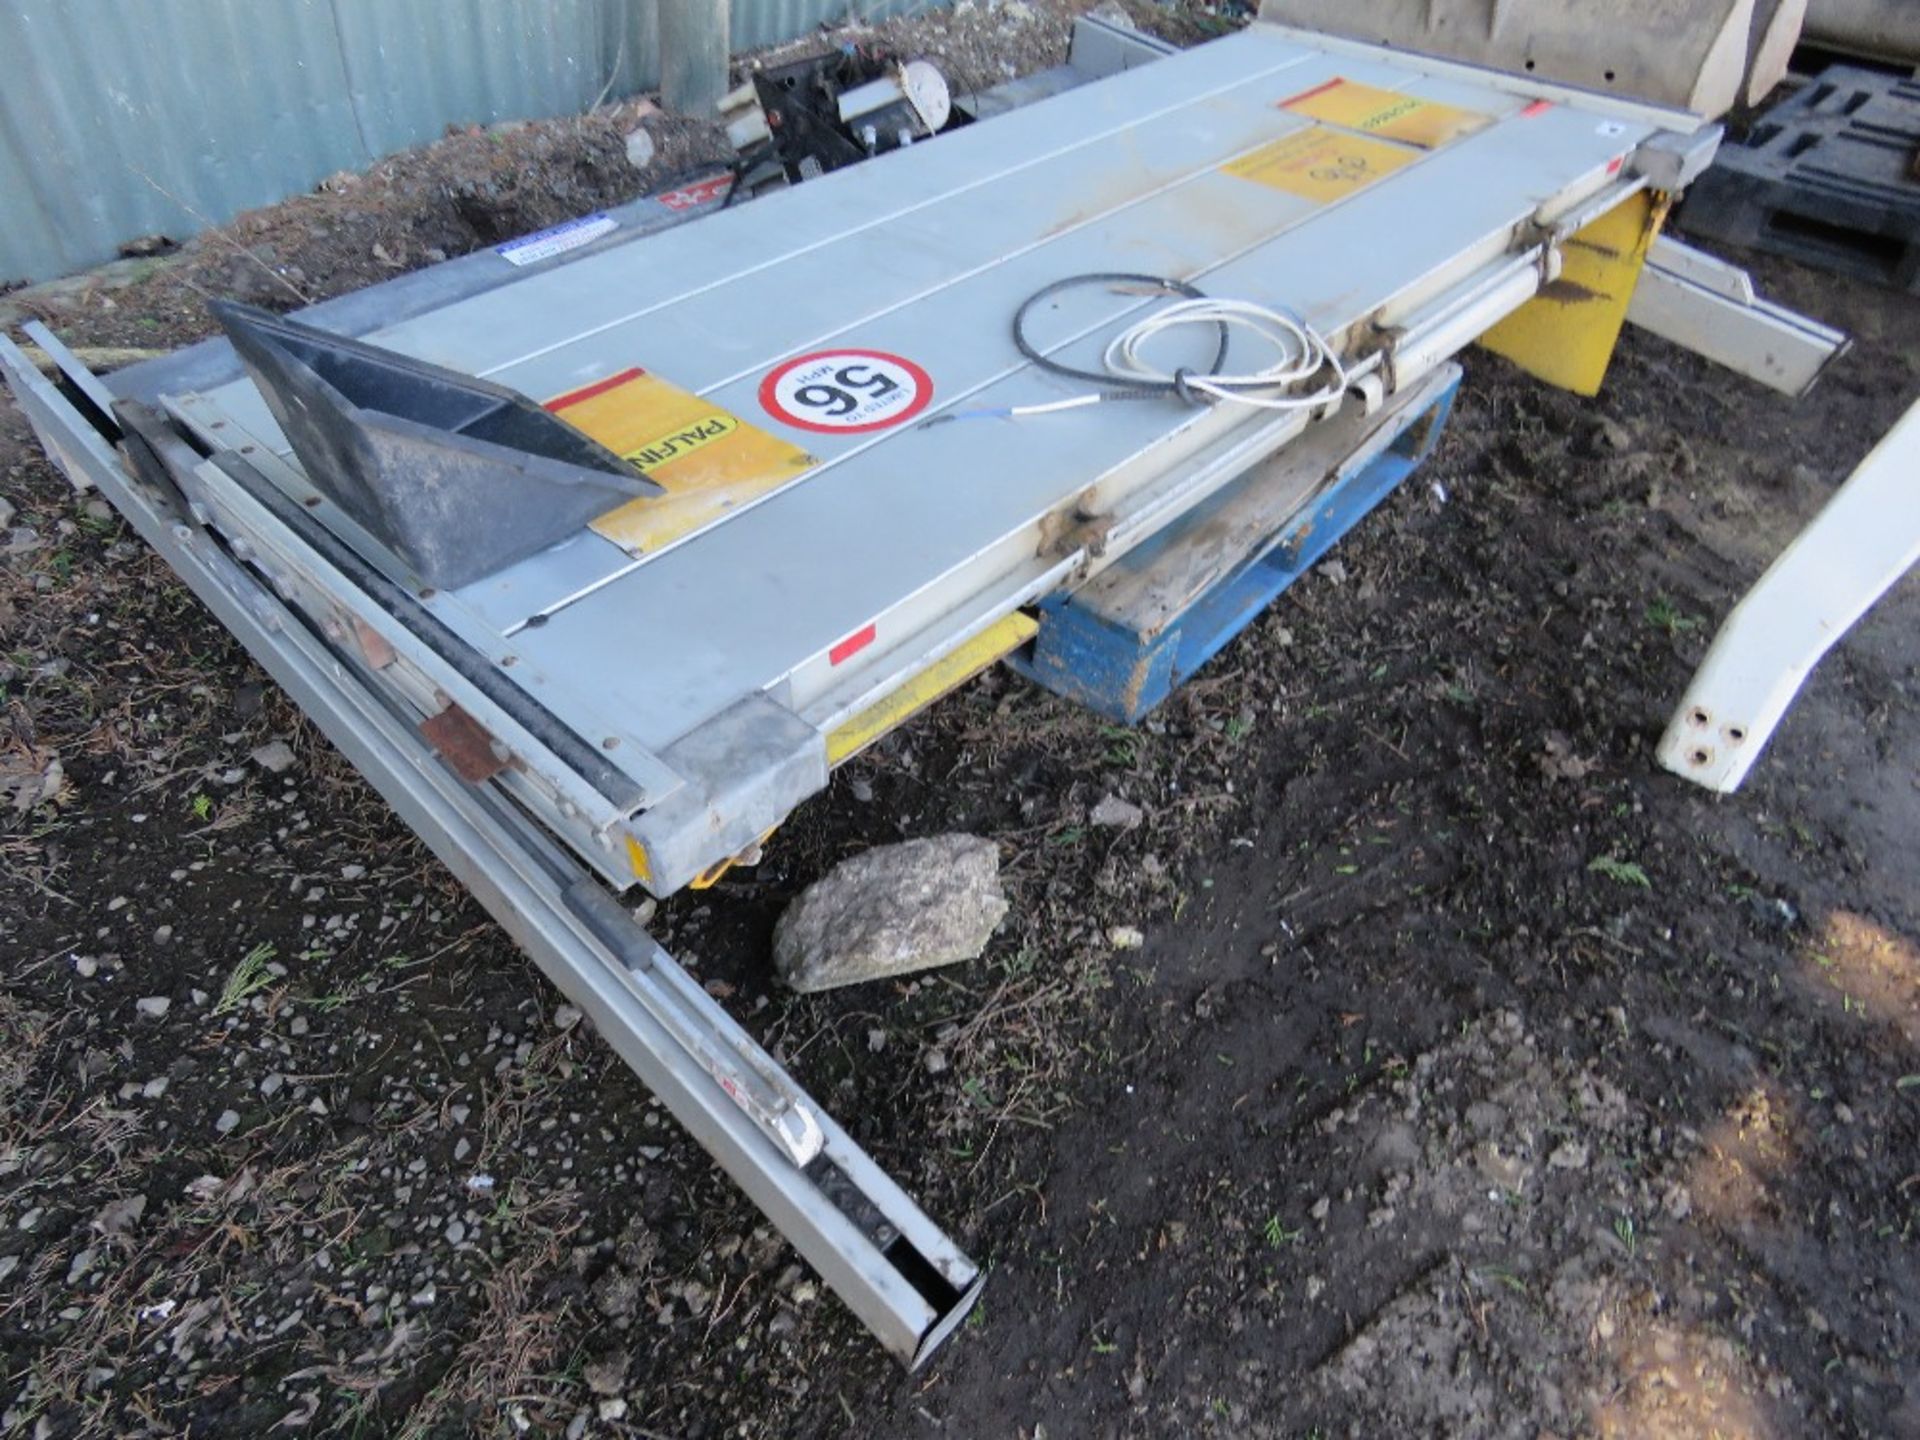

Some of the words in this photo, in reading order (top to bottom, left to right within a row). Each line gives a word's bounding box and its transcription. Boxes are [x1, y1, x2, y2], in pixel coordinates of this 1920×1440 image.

[796, 364, 835, 384] MPH
[794, 365, 899, 416] 56
[863, 387, 912, 413] LIMITED
[845, 411, 865, 423] TO
